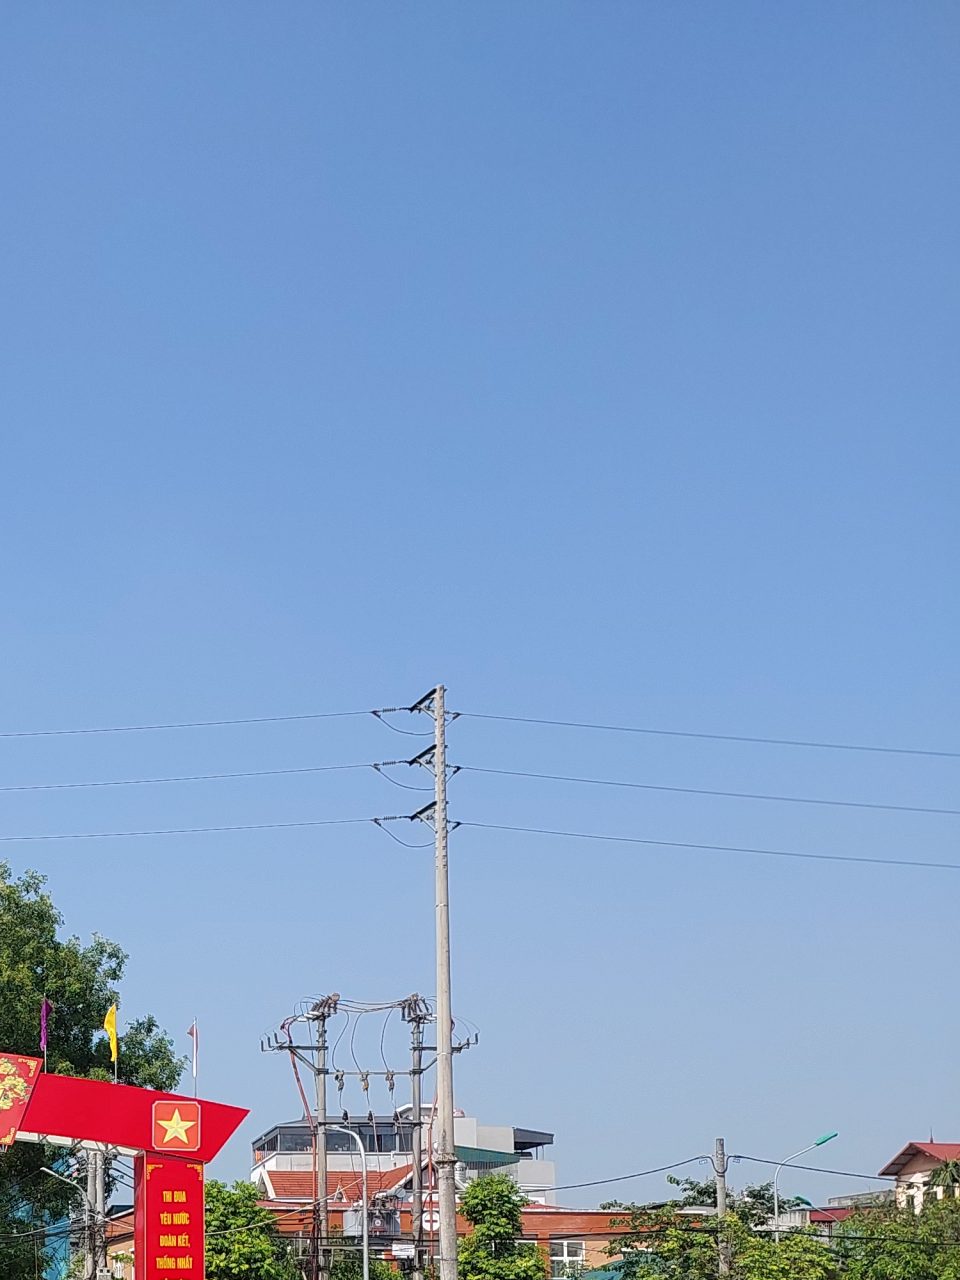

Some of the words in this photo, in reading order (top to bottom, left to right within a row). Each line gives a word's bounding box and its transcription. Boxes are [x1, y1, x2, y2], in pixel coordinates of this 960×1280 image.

[162, 1191, 172, 1202] THI
[174, 1191, 186, 1202] ĐUA
[160, 1212, 172, 1224] YÊU
[172, 1210, 190, 1224] NƯỚC
[160, 1233, 176, 1246] ĐOÀN
[156, 1254, 176, 1269] THỐNG
[176, 1254, 192, 1269] NHẤT
